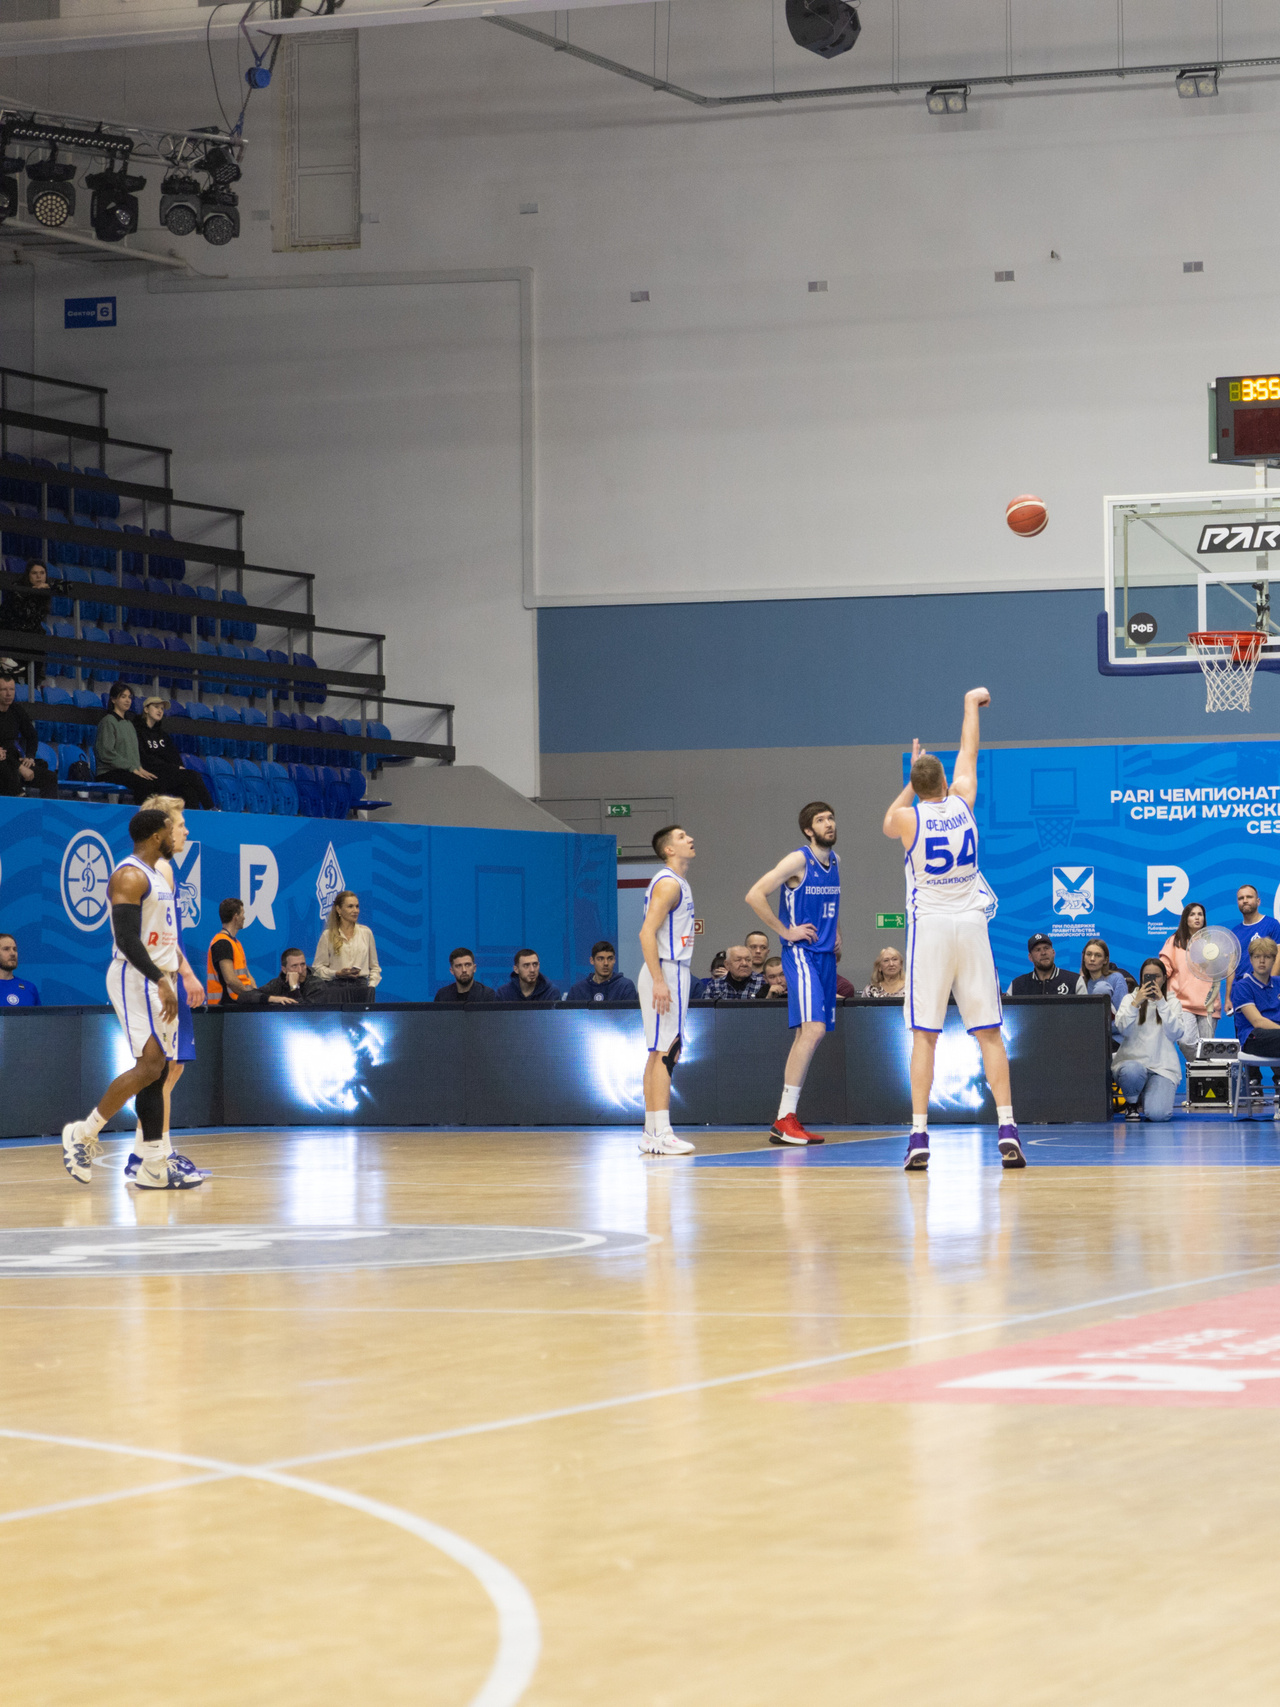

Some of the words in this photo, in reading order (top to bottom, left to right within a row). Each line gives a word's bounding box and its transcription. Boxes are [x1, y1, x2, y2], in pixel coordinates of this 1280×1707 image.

[100, 306, 110, 317] 6
[1130, 623, 1154, 634] РФБ
[1111, 789, 1154, 803] PARI
[1160, 786, 1280, 803] ЧЕМПИОНАТ
[1130, 805, 1197, 821] СРЕДИ
[924, 828, 977, 875] 54
[822, 902, 836, 919] 15
